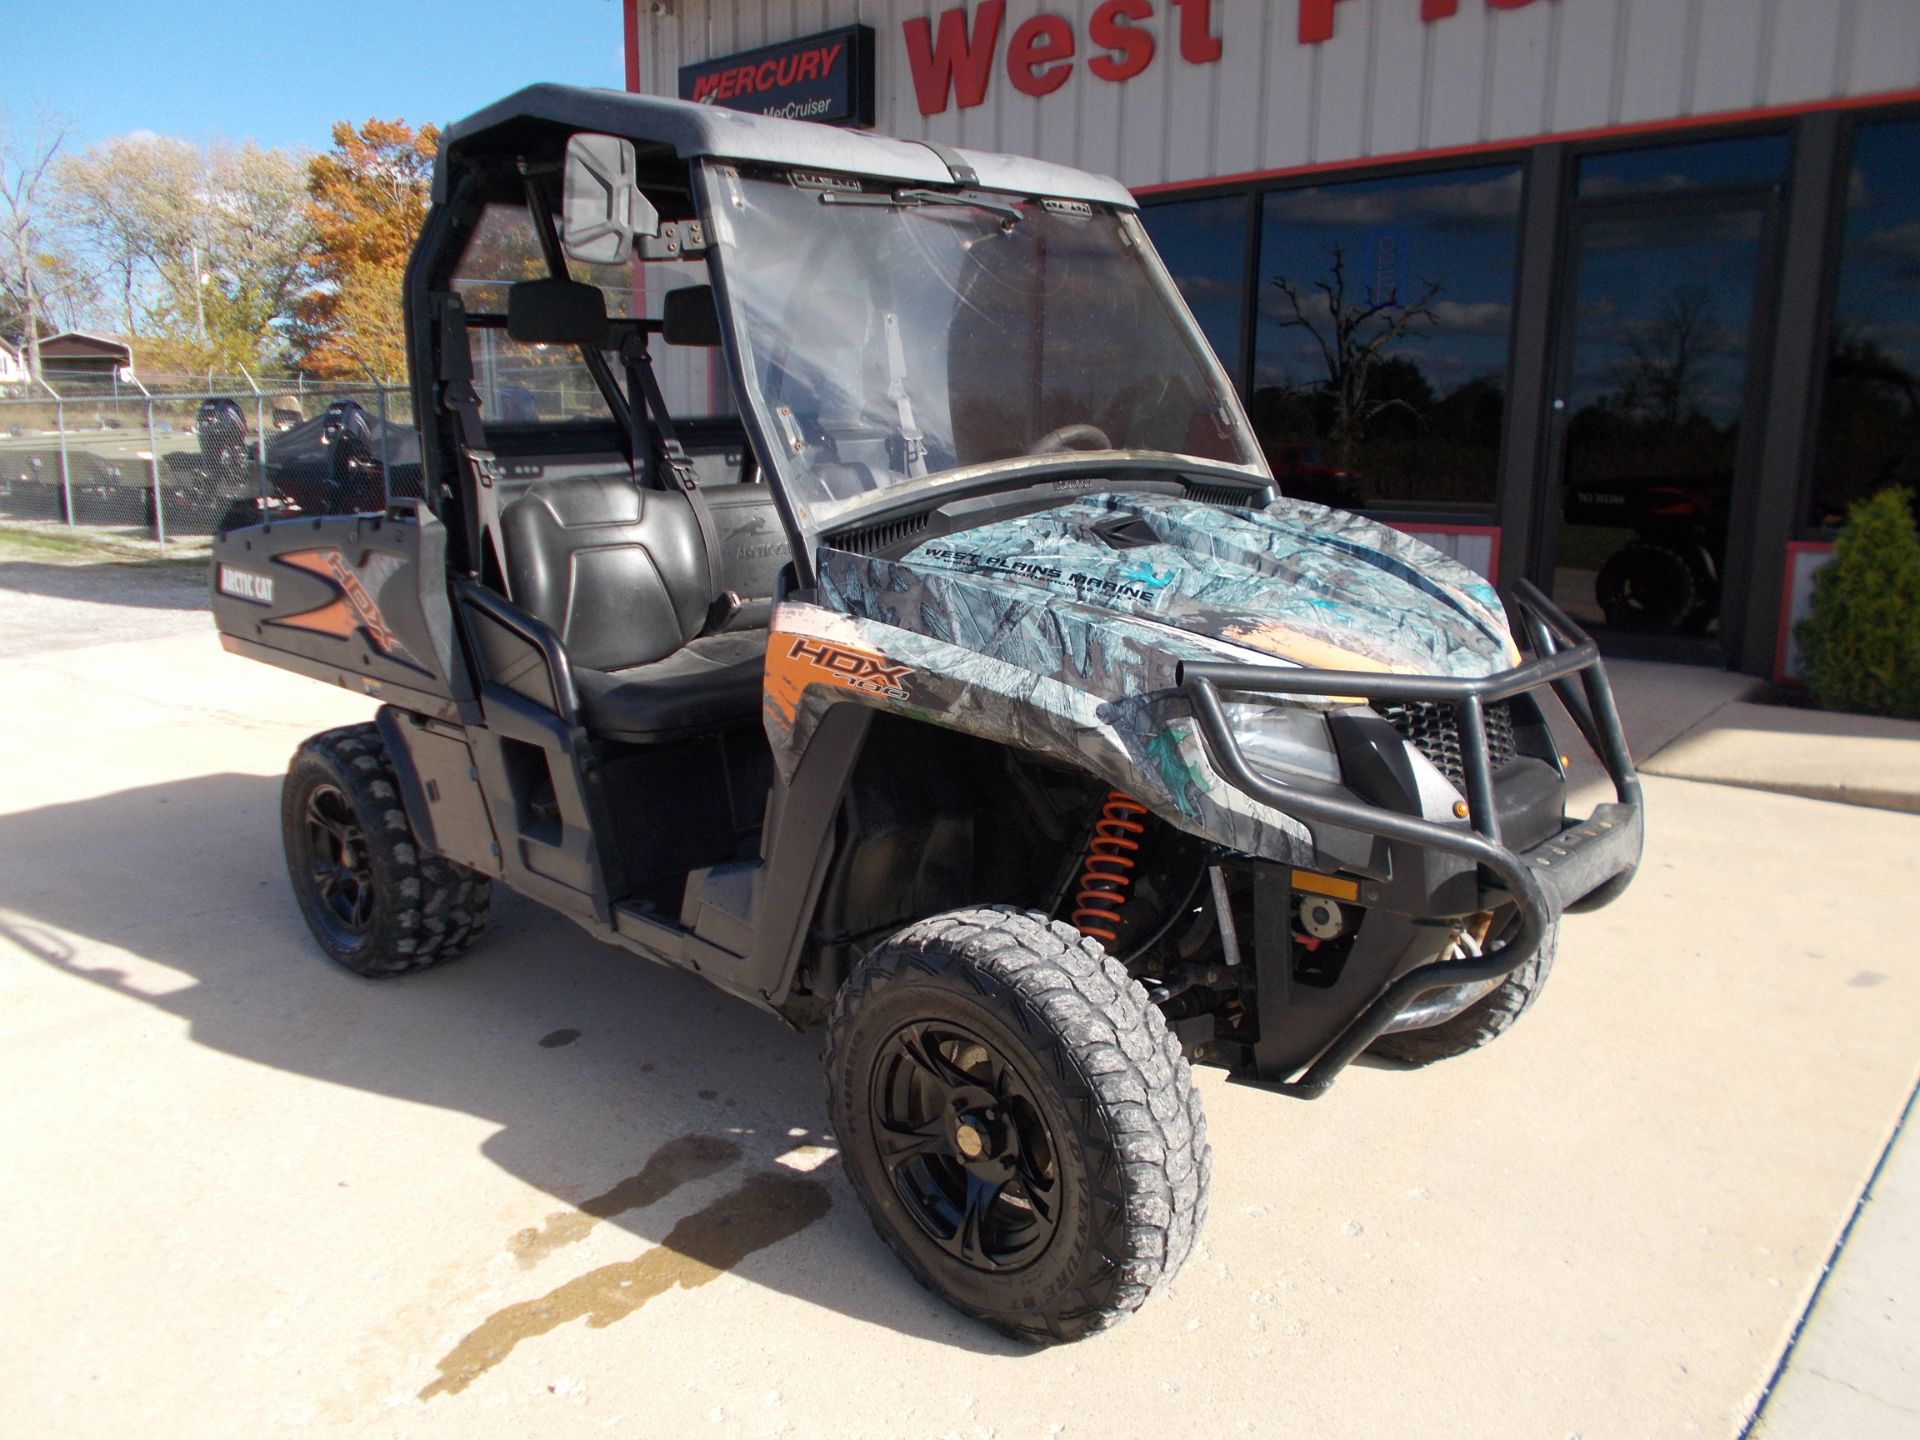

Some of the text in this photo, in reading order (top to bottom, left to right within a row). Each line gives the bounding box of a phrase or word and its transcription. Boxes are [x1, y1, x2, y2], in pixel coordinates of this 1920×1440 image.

[692, 43, 841, 103] MERCURY
[902, 0, 1222, 116] West
[763, 97, 832, 120] MerCruiser
[222, 568, 273, 601] ARCTIC CAT
[925, 548, 982, 562] WEST
[985, 556, 1063, 578] PLAINS
[1068, 572, 1155, 602] MARINE
[786, 636, 917, 690] HDX
[832, 672, 910, 700] 700
